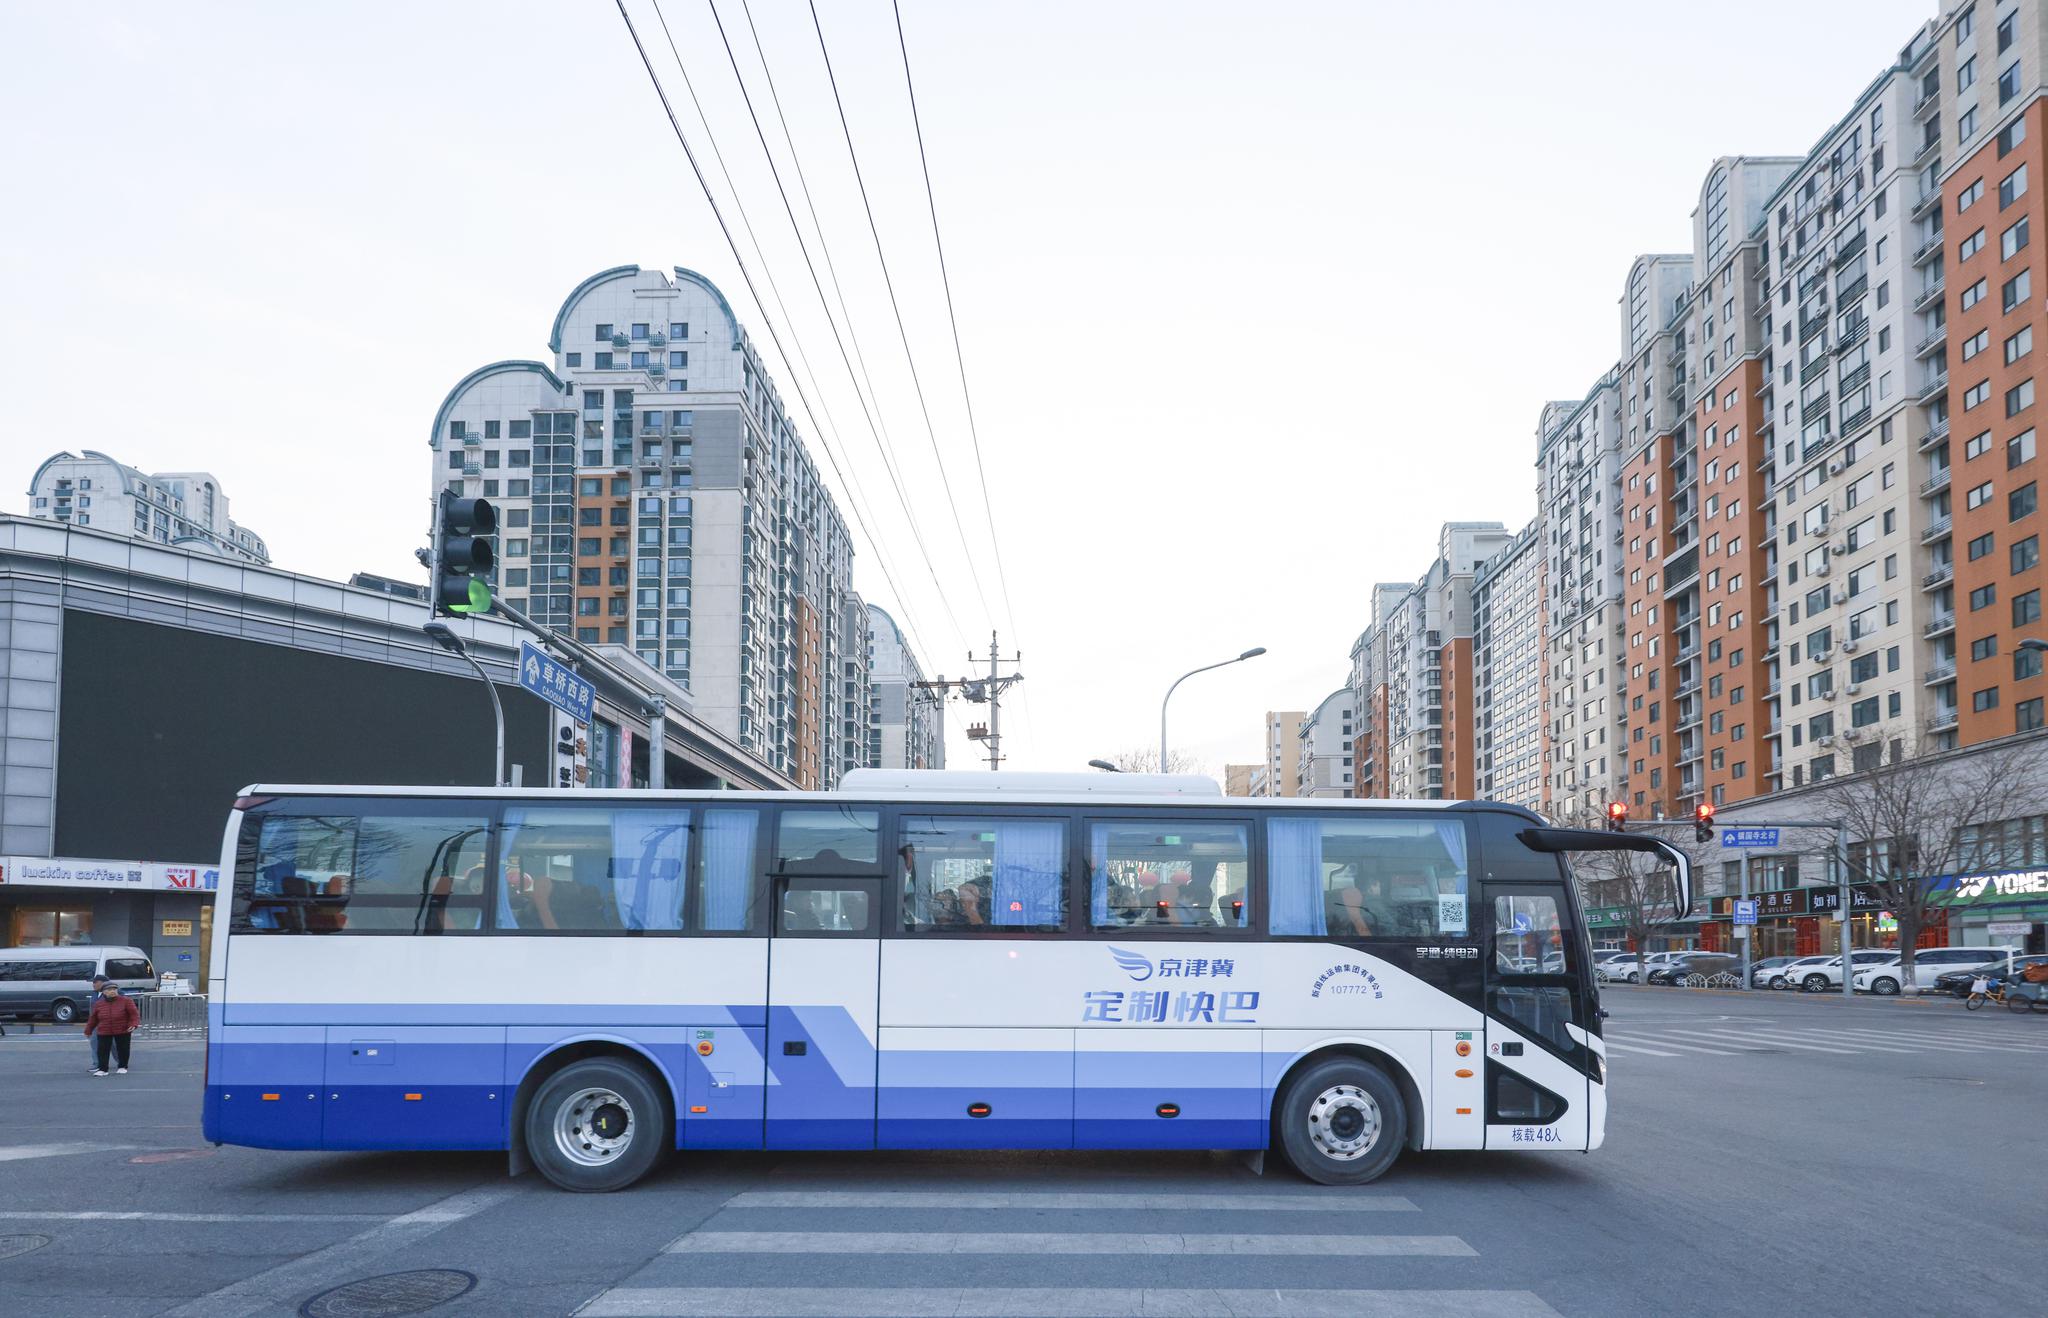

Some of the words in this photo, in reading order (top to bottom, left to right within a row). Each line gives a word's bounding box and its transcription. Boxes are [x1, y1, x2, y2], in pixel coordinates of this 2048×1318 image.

[542, 662, 590, 707] 草桥西路
[21, 865, 71, 880] luckin
[75, 867, 124, 882] coffee
[1992, 871, 2048, 896] YONE
[1813, 891, 1867, 908] 如初店
[1158, 958, 1235, 978] 京津冀
[1311, 963, 1383, 999] 新国线运输集团有限公司
[1330, 985, 1368, 994] 107772
[1082, 990, 1261, 1023] 定制快巴
[1512, 1127, 1562, 1142] 核载48人
